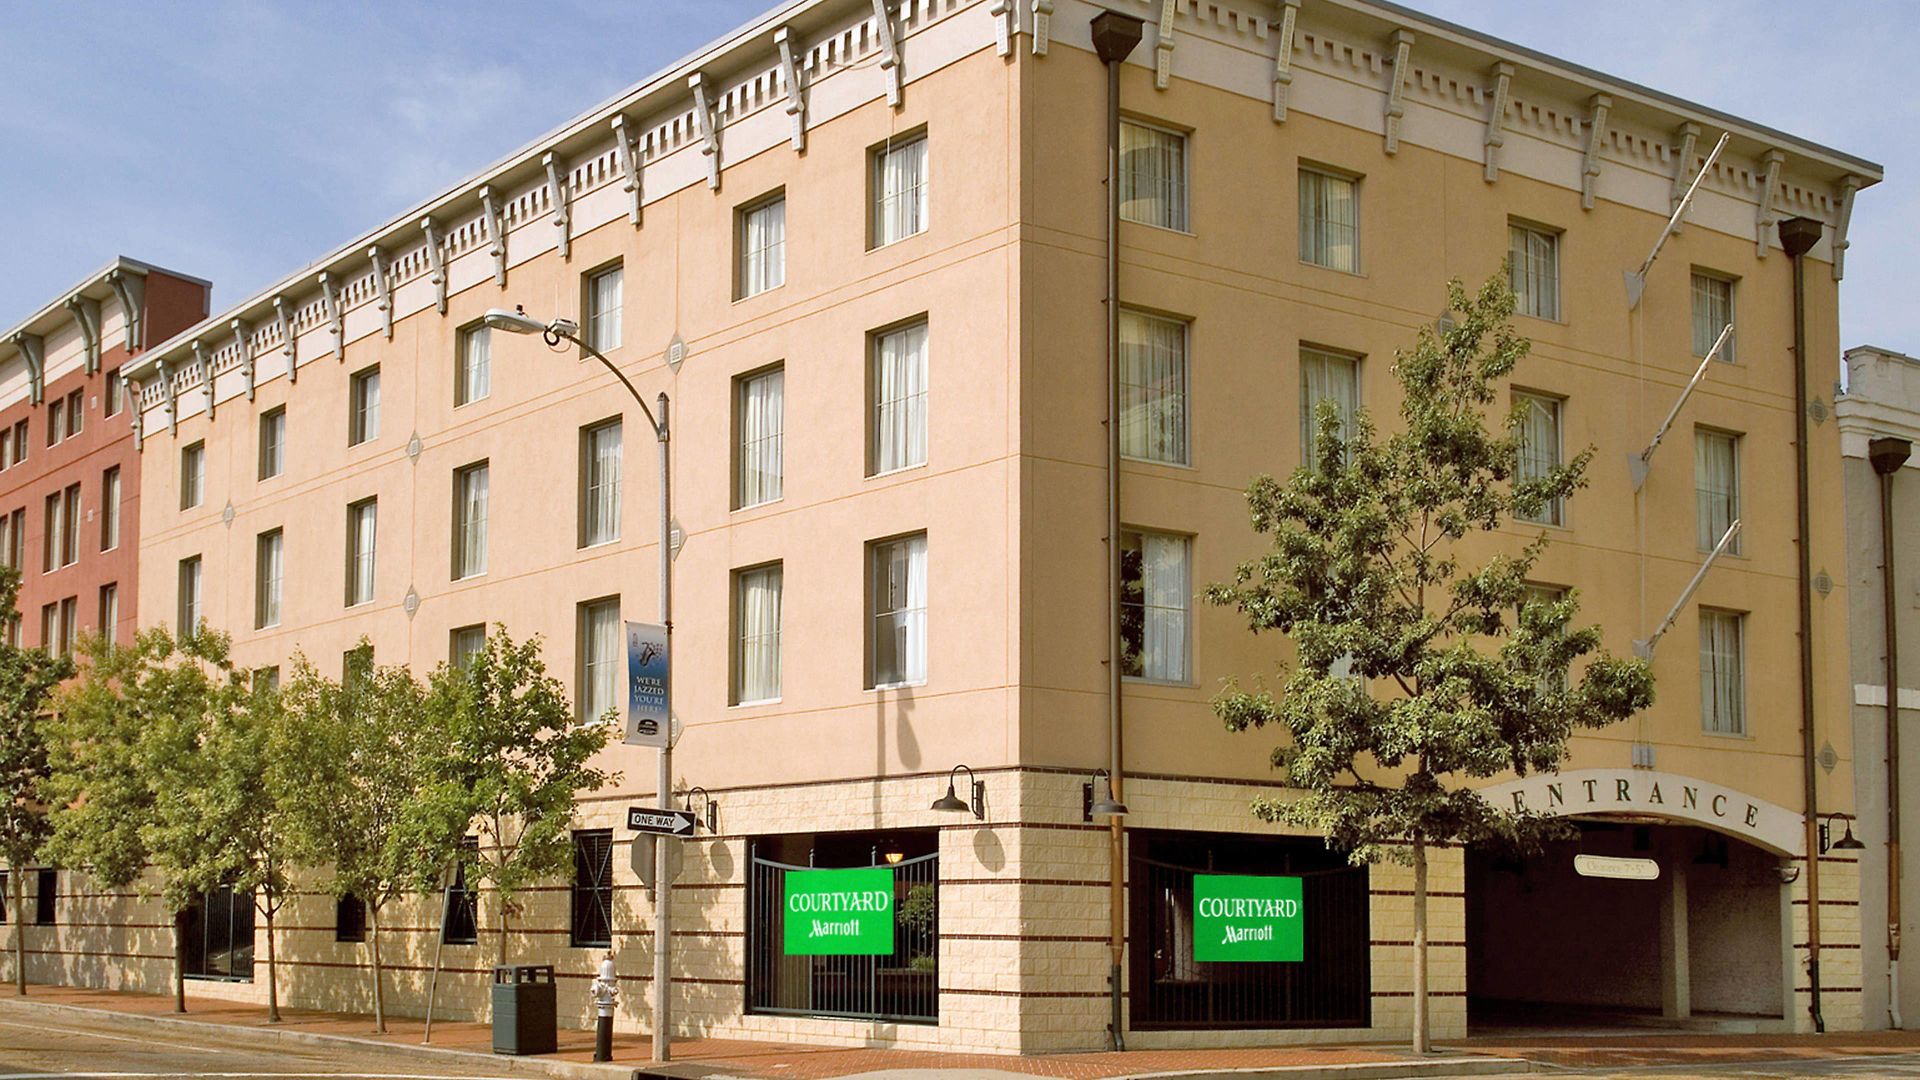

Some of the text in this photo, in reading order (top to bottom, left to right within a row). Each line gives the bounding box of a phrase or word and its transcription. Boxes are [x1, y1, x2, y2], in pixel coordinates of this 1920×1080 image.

[634, 685, 664, 695] JAZZED
[1512, 778, 1759, 829] ENTRANCE
[634, 814, 675, 827] ONE WAY
[789, 890, 889, 913] COURTYARD
[1199, 897, 1298, 918] COURTYARD
[808, 919, 860, 938] Marriott
[1221, 925, 1273, 945] Marriott
